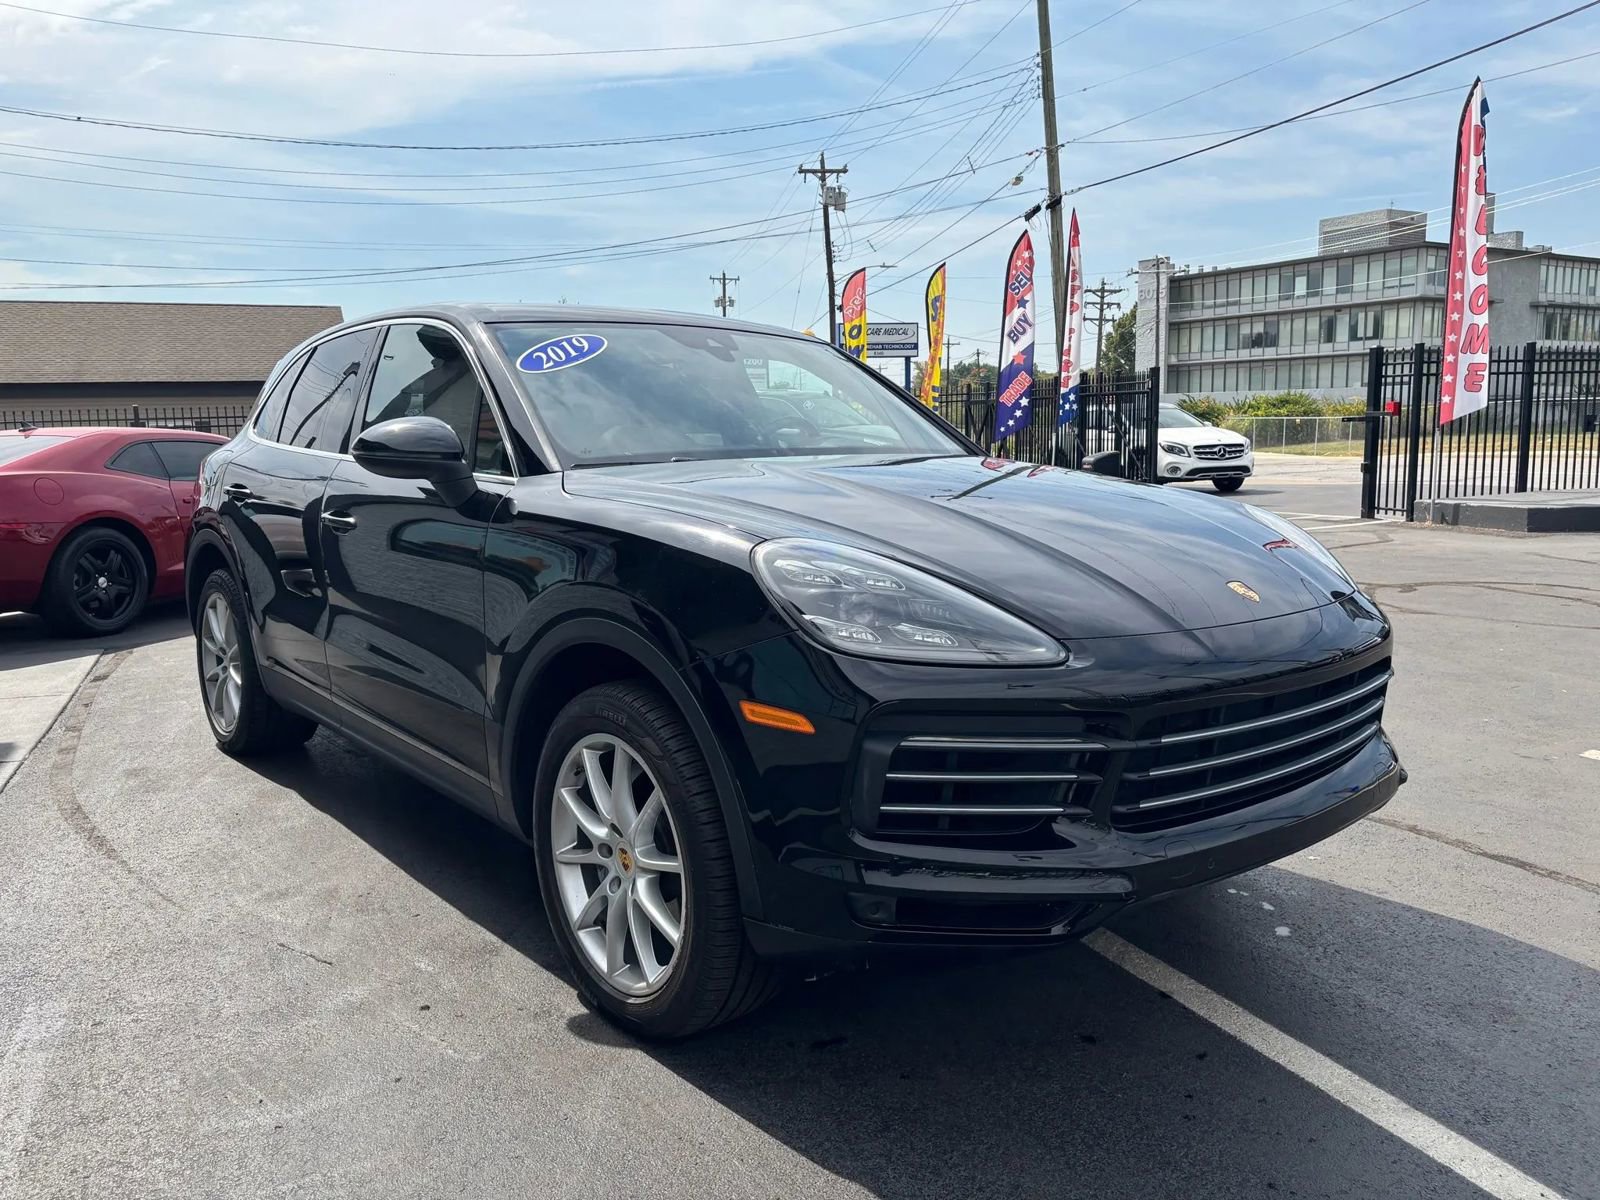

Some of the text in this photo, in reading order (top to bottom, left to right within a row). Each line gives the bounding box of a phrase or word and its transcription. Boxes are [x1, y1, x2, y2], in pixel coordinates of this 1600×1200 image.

[1138, 287, 1166, 300] 805
[866, 328, 909, 336] CARE MEDICAL
[1007, 311, 1033, 345] BUY
[533, 336, 589, 369] 2019
[1000, 371, 1033, 407] TRADE
